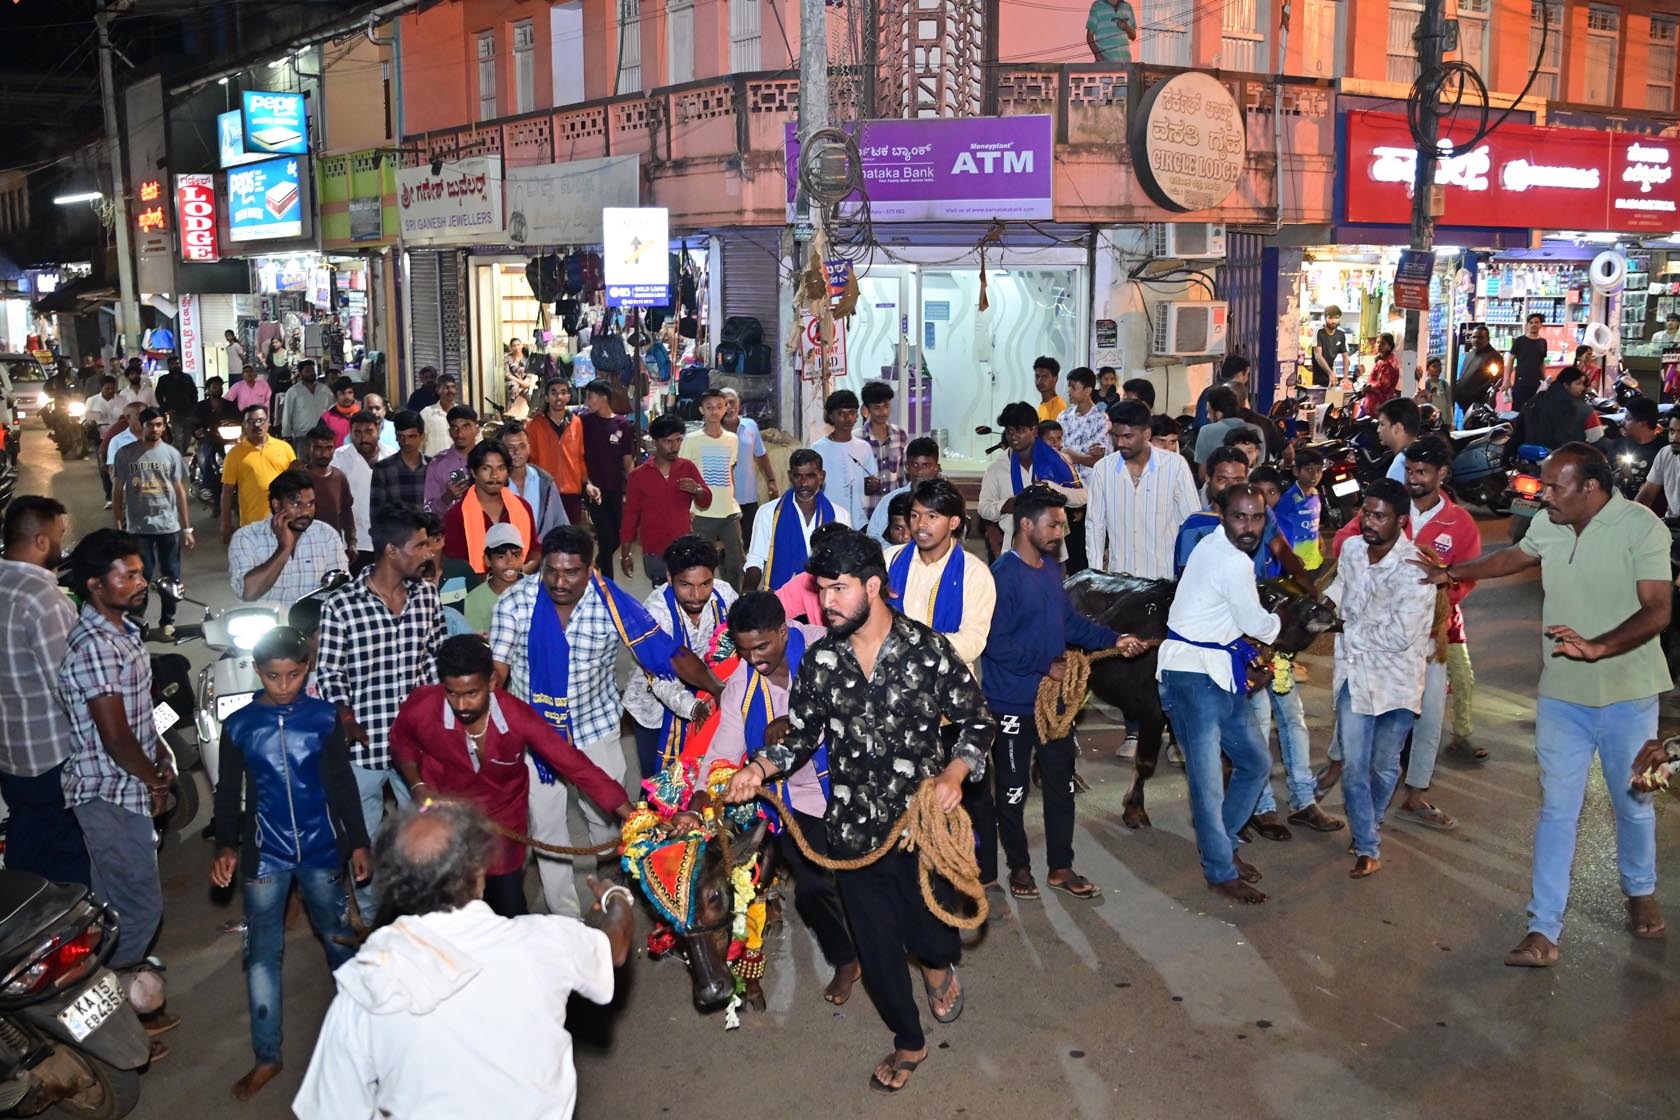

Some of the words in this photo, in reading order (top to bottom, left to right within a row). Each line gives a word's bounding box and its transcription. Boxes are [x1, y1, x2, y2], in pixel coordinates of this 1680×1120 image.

[1152, 116, 1200, 146] ವಸತಿ
[1208, 128, 1241, 160] ಗೃಹ
[903, 167, 935, 178] Bank
[951, 151, 1033, 174] ATM
[1152, 149, 1197, 176] CIRCLE
[1198, 156, 1238, 183] LODGE
[182, 187, 214, 260] LODGE
[418, 216, 446, 230] GANESH
[449, 212, 492, 227] JEWELLERS
[73, 996, 96, 1015] KA
[92, 980, 110, 998] 15
